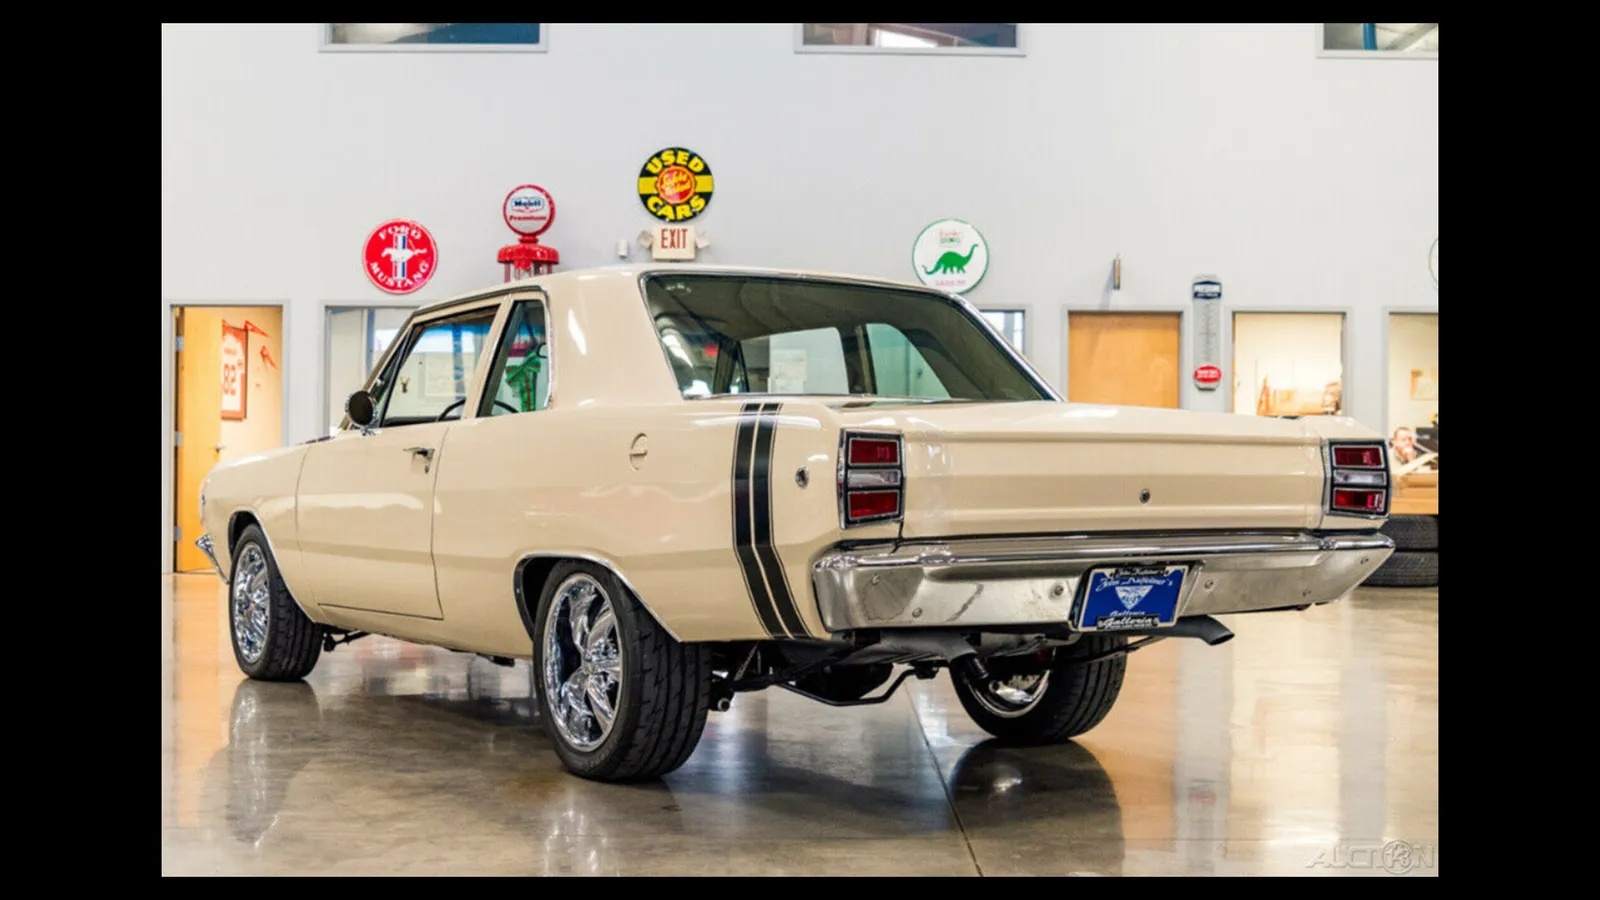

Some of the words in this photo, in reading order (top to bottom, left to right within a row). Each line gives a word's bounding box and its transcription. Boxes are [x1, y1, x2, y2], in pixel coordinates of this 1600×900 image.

[646, 149, 704, 174] USED
[647, 195, 706, 221] CARS
[379, 225, 422, 240] FORD
[661, 228, 688, 249] EXIT
[370, 261, 429, 288] MUSTANG
[1095, 578, 1120, 592] John
[1101, 617, 1153, 629] Galleria
